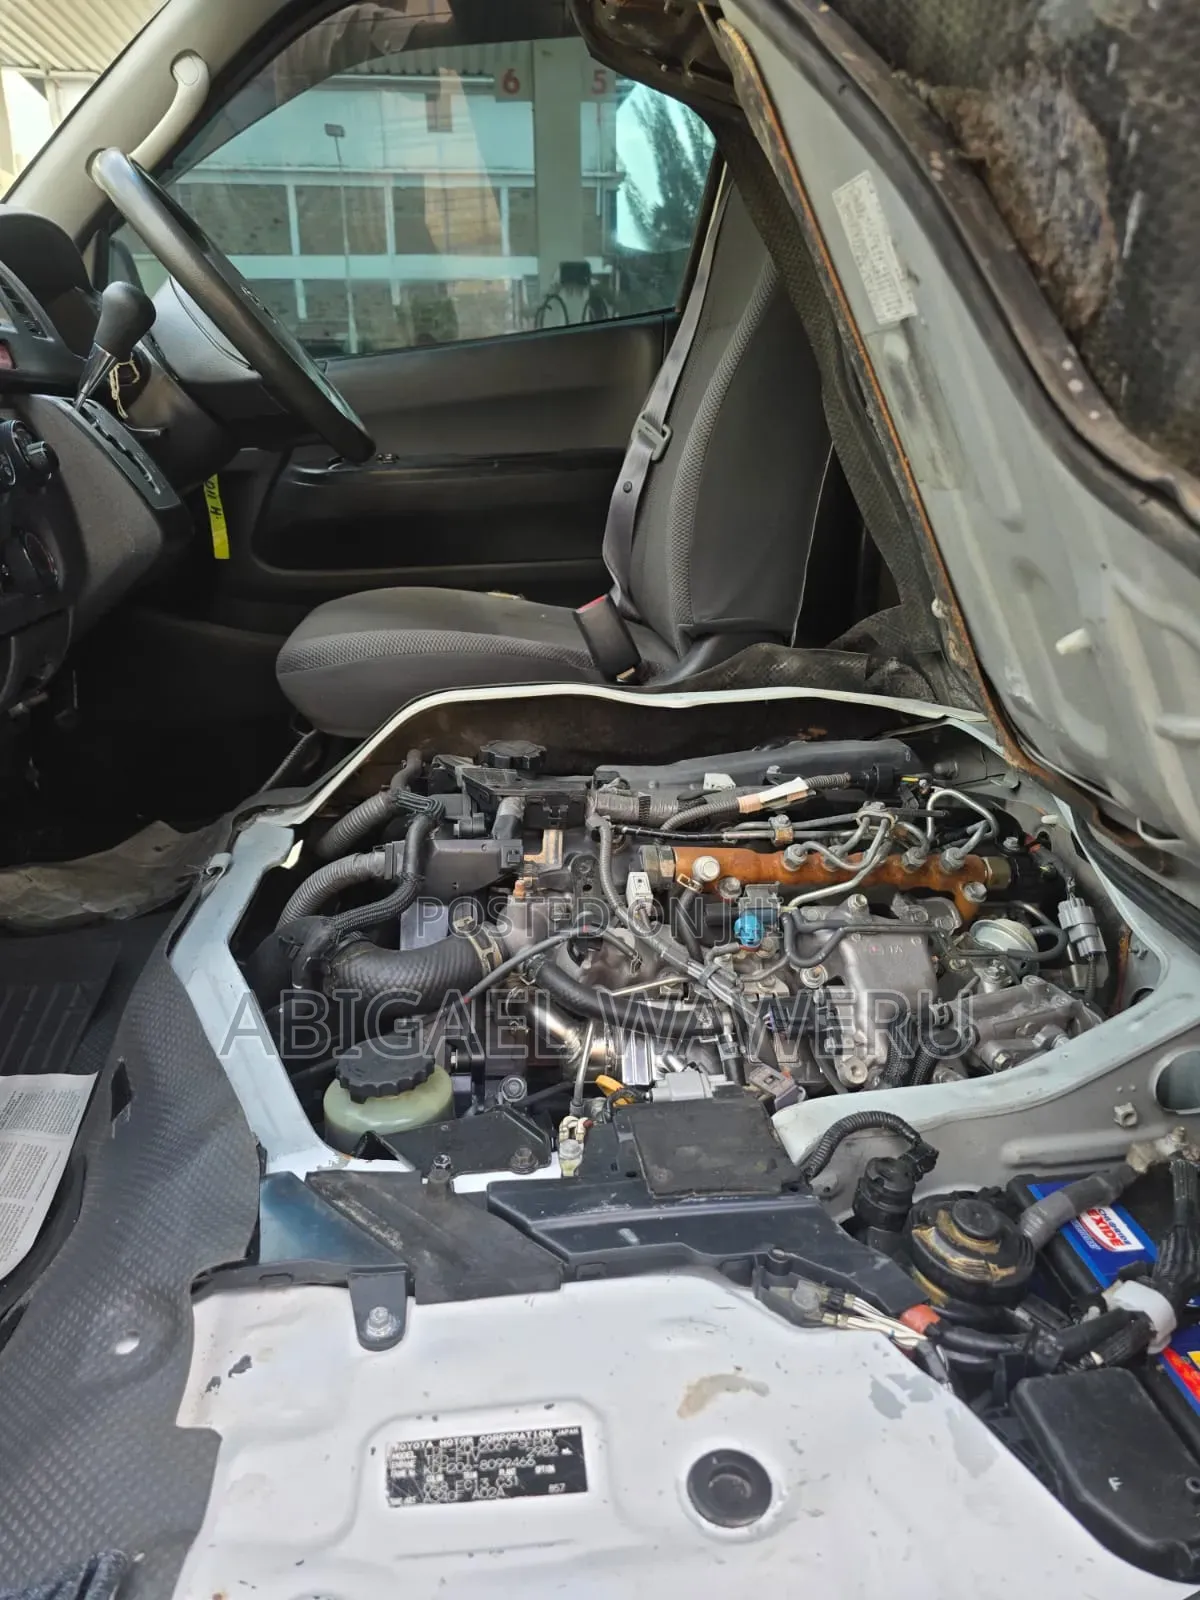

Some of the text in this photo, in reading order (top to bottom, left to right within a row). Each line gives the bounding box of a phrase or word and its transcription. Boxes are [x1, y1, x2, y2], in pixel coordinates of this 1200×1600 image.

[502, 68, 521, 95] 6
[591, 69, 608, 95] 5
[1087, 1208, 1126, 1247] EXIDE
[392, 1427, 579, 1453] TOYOTA MOTOR CORPORATION JAPAN
[526, 1444, 560, 1458] 2982
